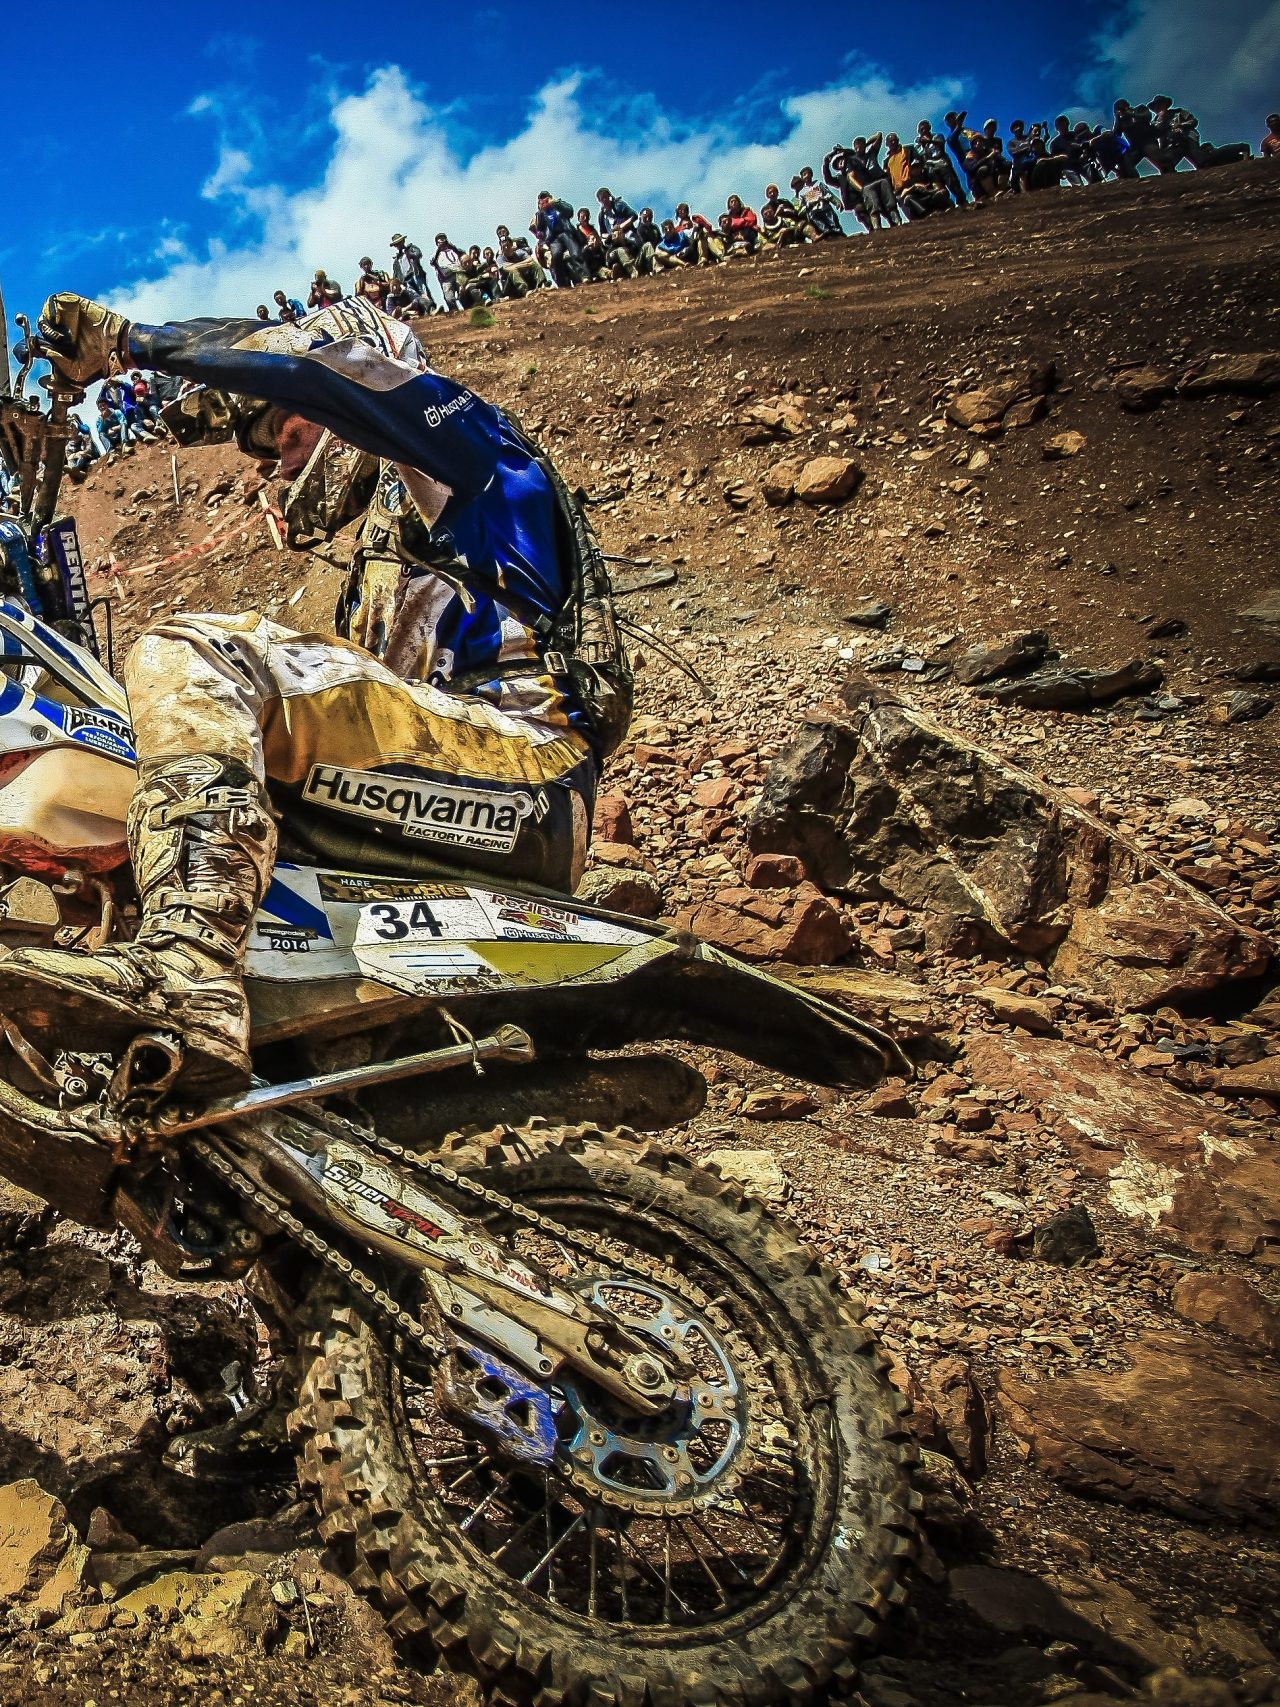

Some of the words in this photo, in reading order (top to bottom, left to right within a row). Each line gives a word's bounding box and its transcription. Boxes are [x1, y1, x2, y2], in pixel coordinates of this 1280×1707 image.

[308, 767, 518, 832] Husqvarna
[407, 825, 465, 843] FACTORY
[466, 835, 510, 850] RACING
[340, 878, 371, 888] HARE
[370, 902, 443, 940] 34
[272, 938, 308, 951] 2014
[519, 929, 581, 941] Husqvarna
